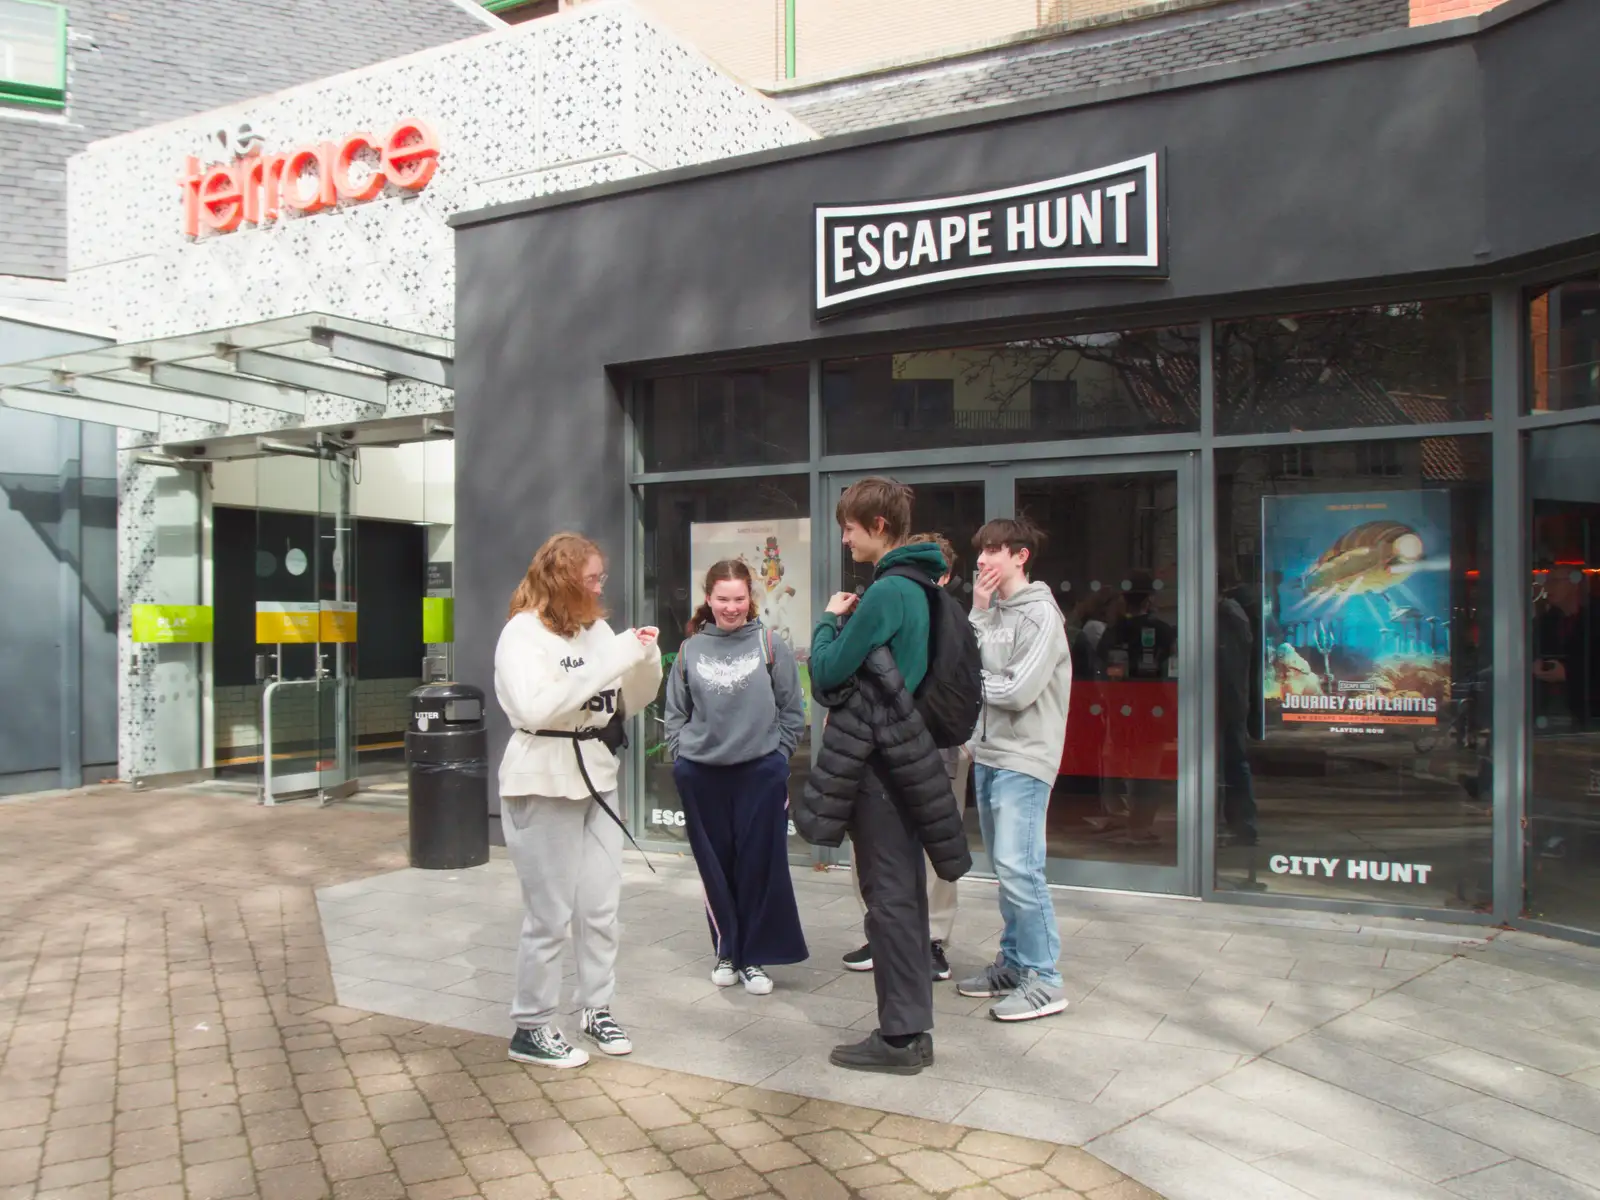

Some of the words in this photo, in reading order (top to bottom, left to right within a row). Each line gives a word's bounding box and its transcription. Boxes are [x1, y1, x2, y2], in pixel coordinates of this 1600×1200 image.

[176, 117, 440, 237] terrace
[833, 210, 993, 284] ESCAPE
[1006, 180, 1137, 252] HUNT
[157, 617, 188, 628] PLAY
[1281, 692, 1346, 710] JOURNEY
[1348, 697, 1364, 711] TO
[1365, 693, 1437, 712] ATLANTIS
[414, 711, 440, 720] LITTER
[1330, 726, 1364, 734] PLAYING
[1365, 727, 1385, 735] NOW
[1269, 854, 1340, 877] CITY
[1347, 859, 1432, 884] HUNT
